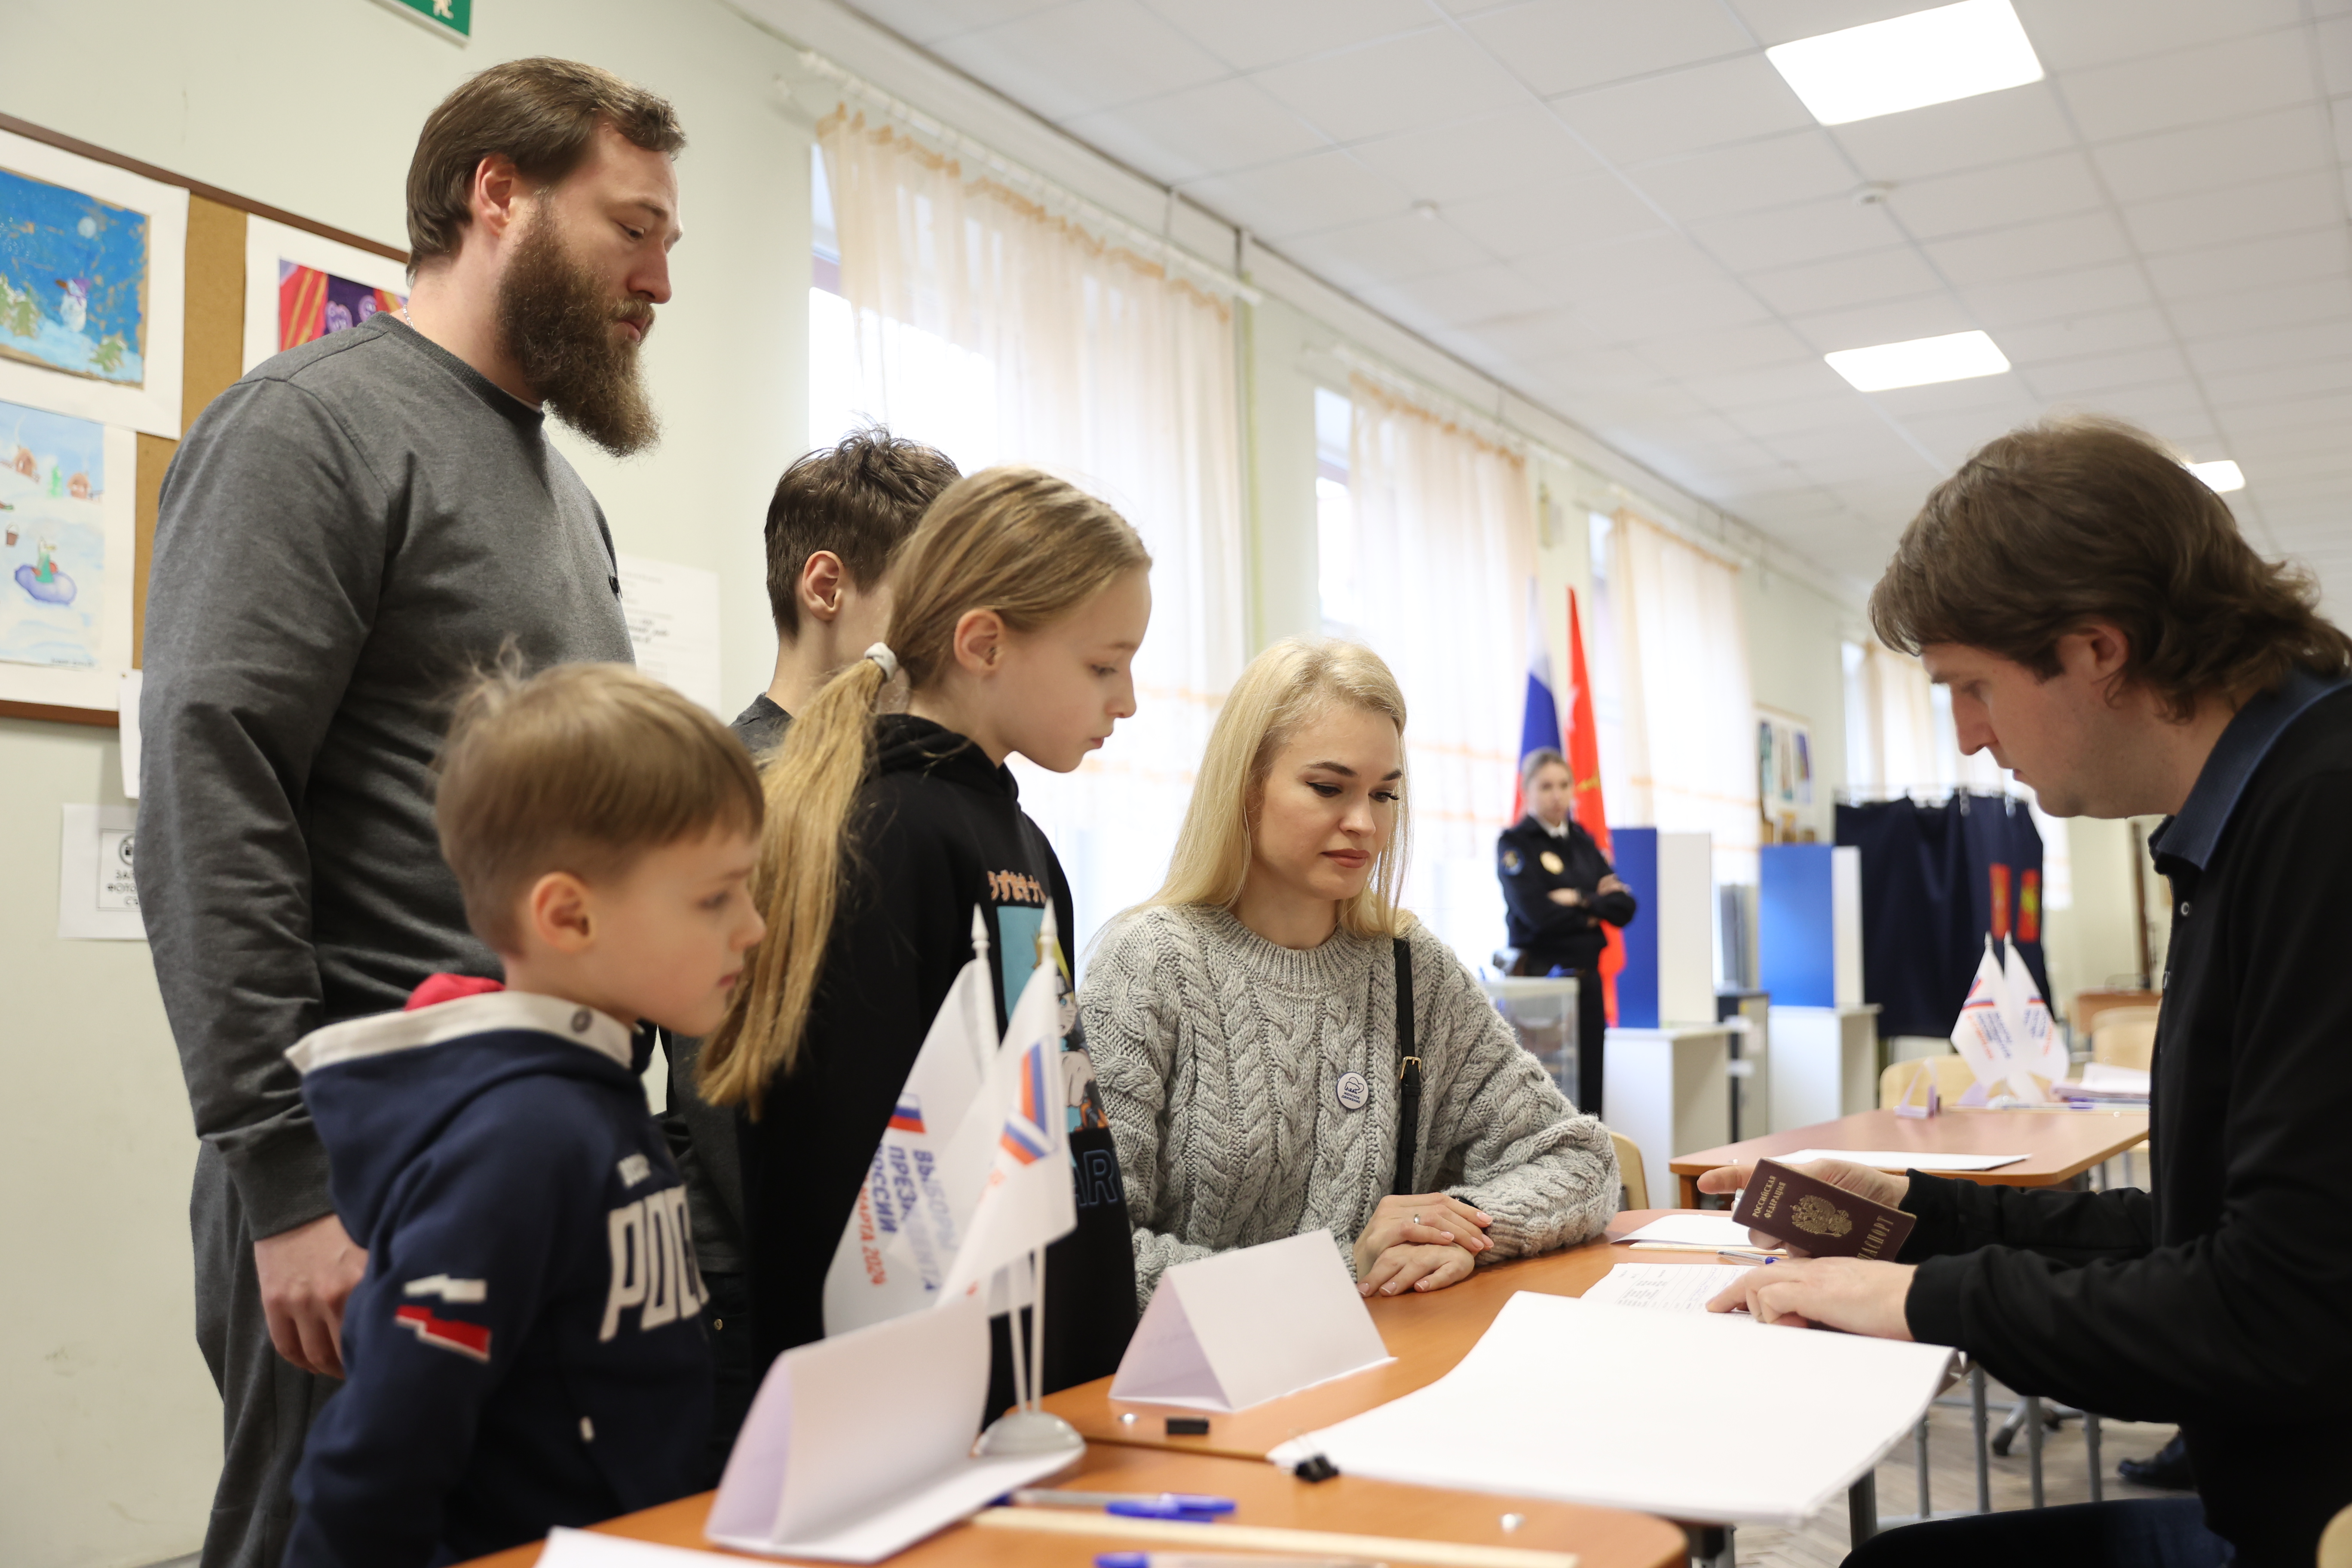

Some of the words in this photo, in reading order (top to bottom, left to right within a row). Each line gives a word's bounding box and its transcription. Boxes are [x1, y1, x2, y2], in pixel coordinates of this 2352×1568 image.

[1341, 1095, 1360, 1103] ДВИЖЕНИЕ
[1752, 1175, 1776, 1217] РОССИЙСКАЯ
[1764, 1182, 1786, 1218] ФЕДЕРАЦИЯ
[1857, 1216, 1893, 1260] ПАСПОРТ
